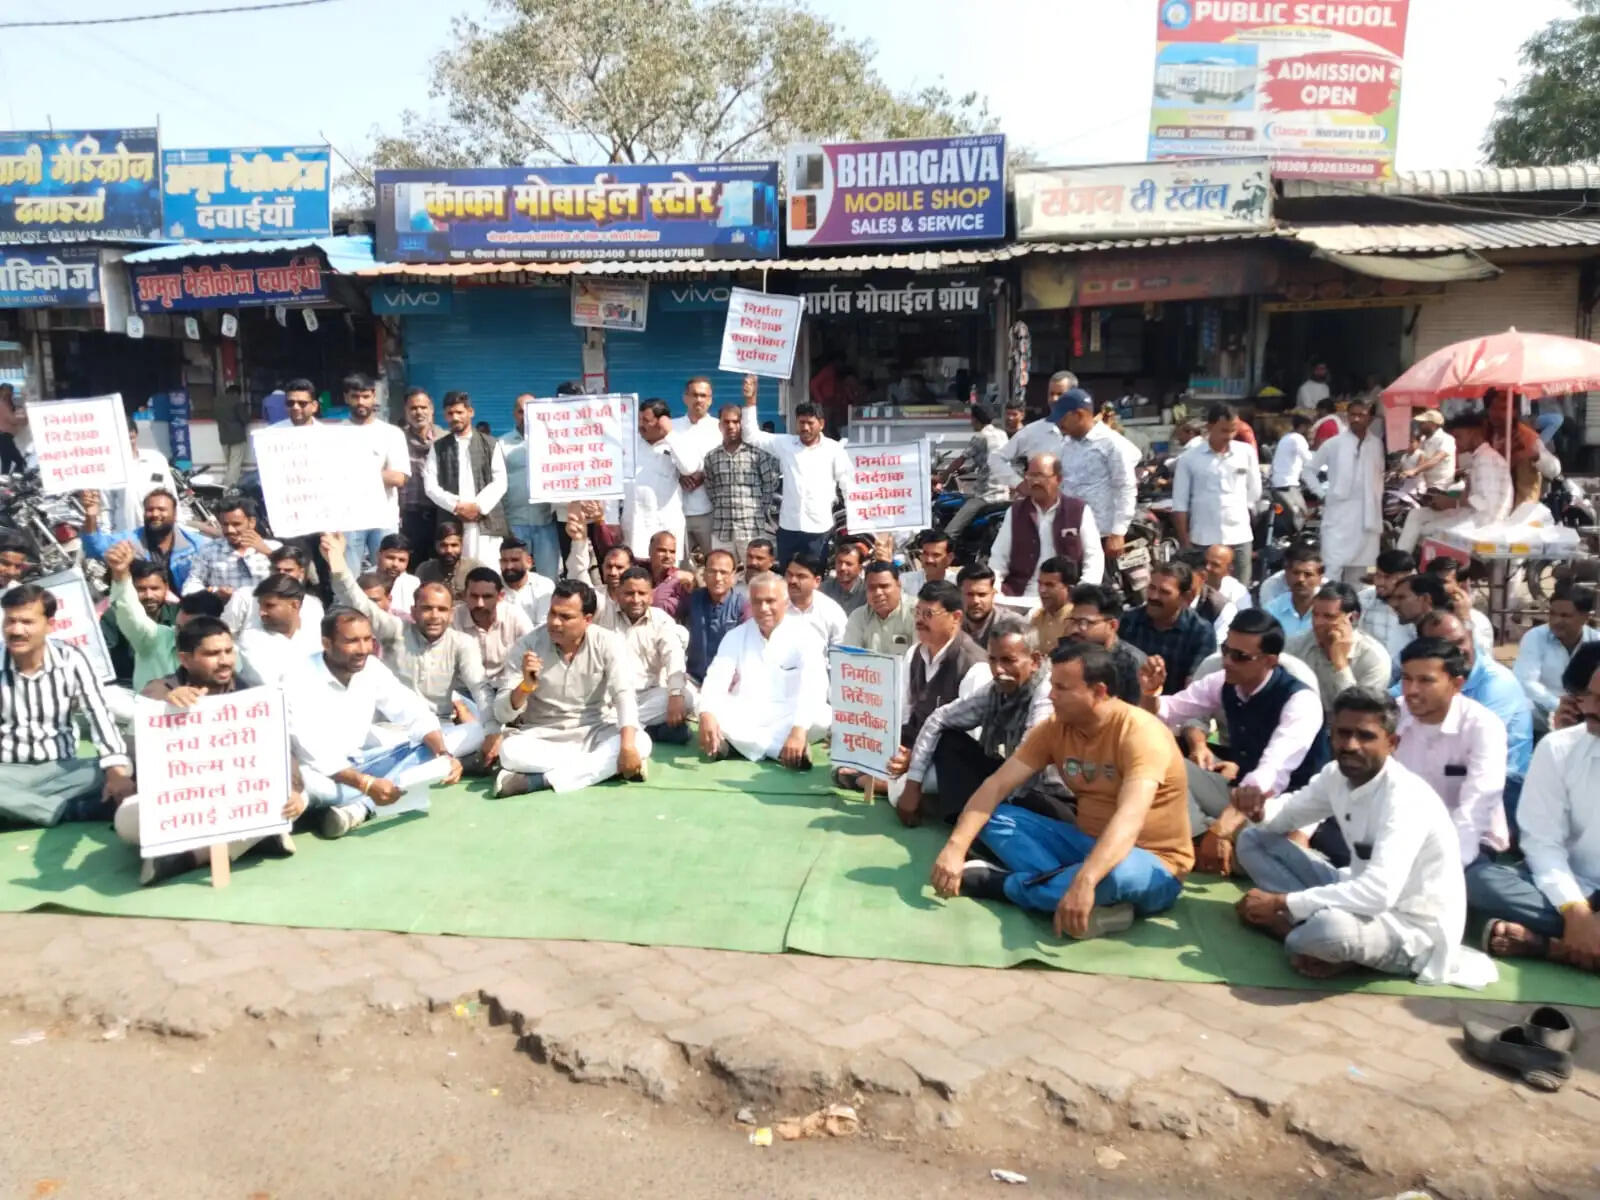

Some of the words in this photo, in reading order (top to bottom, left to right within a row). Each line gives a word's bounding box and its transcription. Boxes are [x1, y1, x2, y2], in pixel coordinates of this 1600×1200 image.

[1195, 3, 1288, 23] PUBLIC
[1293, 5, 1397, 27] SCHOOL
[1277, 61, 1385, 83] ADMISSION
[1300, 85, 1357, 106] OPEN
[837, 145, 1000, 188] BHARGAVA
[426, 182, 506, 217] काका
[513, 172, 641, 222] मोबाईल
[648, 171, 718, 216] स्टोर
[844, 190, 925, 214] MOBILE
[931, 187, 991, 210] SHOP
[1041, 178, 1125, 218] संजय
[1129, 178, 1157, 213] टी
[851, 217, 897, 236] SALES
[901, 217, 914, 233] &
[917, 212, 985, 233] SERVICE
[0, 256, 95, 290] डिकोज
[383, 288, 440, 307] vivo
[671, 284, 730, 303] vivo
[856, 282, 935, 315] मोबाईल
[938, 281, 980, 310] शॉप
[855, 452, 901, 467] निर्माता
[840, 663, 882, 685] निर्माता
[148, 711, 203, 728] यादव
[211, 703, 238, 722] जी
[246, 701, 270, 719] की
[166, 737, 200, 753] लव
[209, 726, 257, 748] स्टोरी
[167, 759, 224, 778] फिल्म
[233, 755, 257, 769] पर
[237, 777, 271, 796] रोक
[160, 806, 217, 831] लगाई
